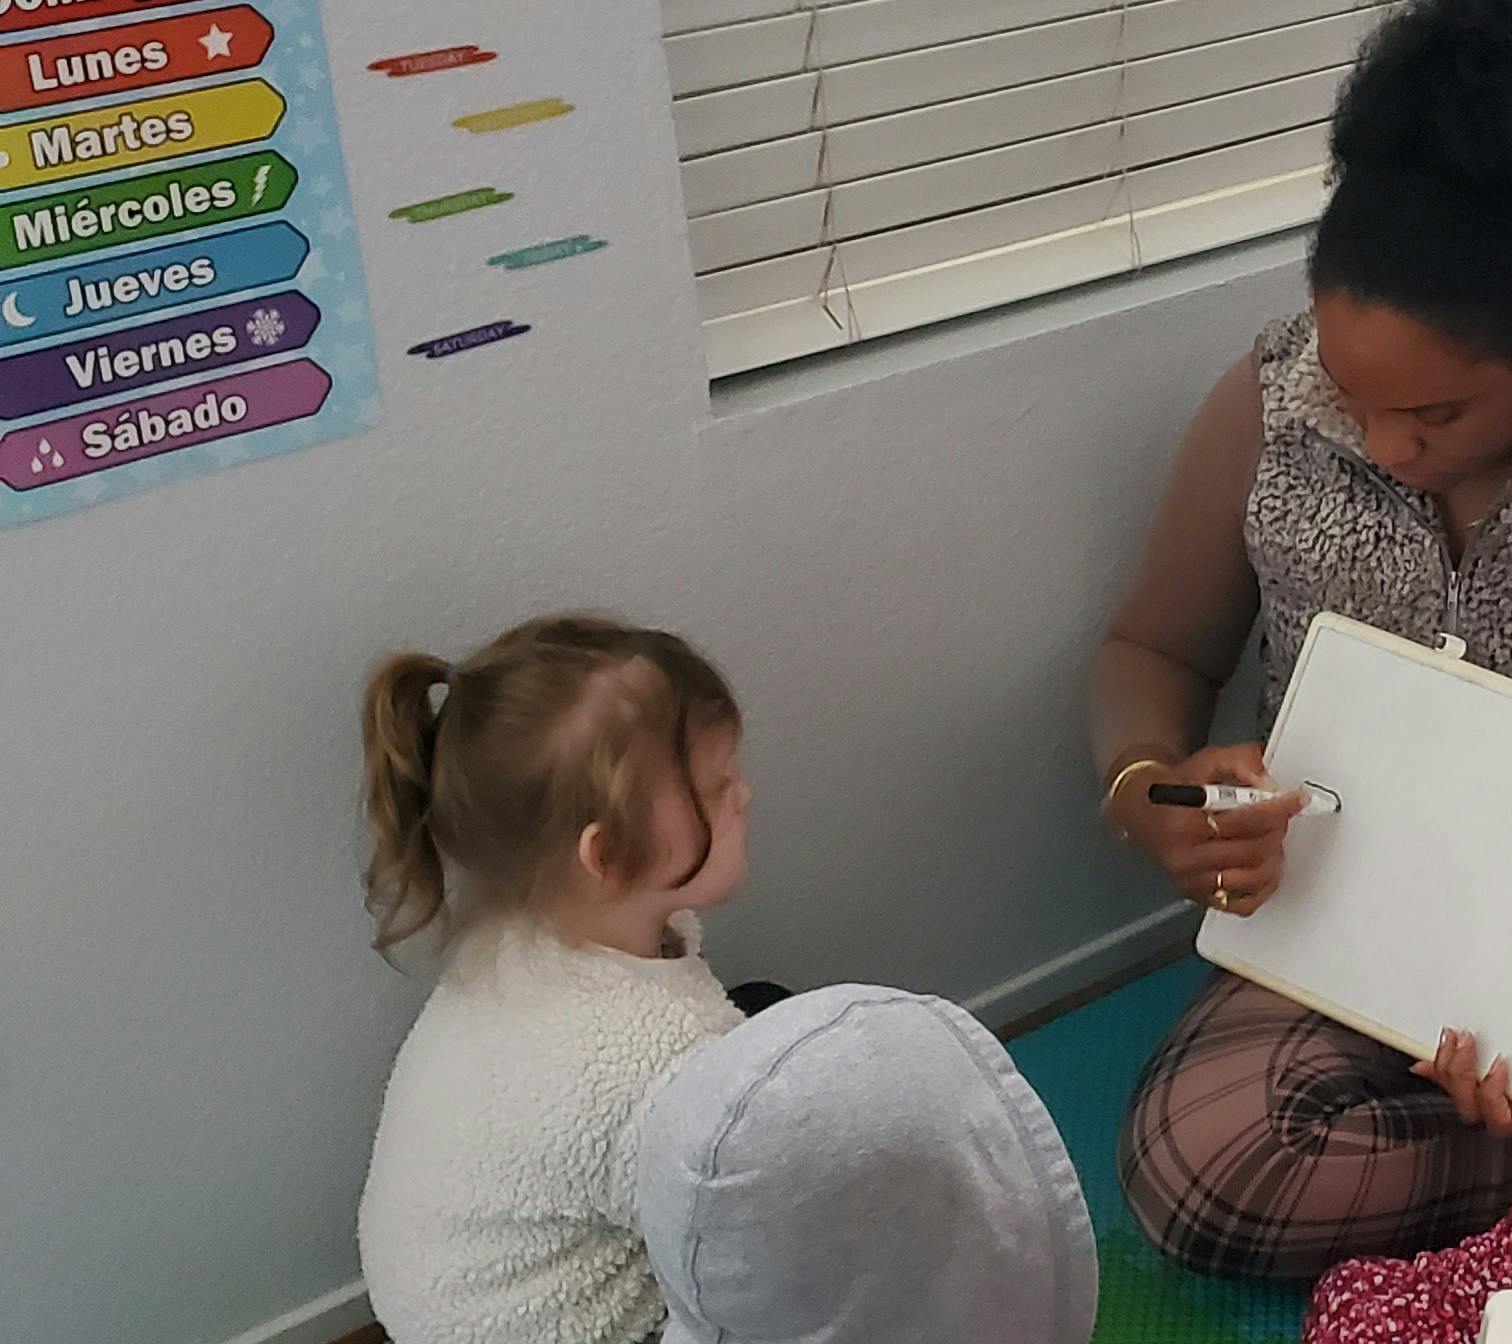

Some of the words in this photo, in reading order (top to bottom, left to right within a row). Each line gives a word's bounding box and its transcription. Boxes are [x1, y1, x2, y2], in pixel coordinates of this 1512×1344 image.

[27, 40, 168, 91] Lunes
[30, 112, 194, 168] Martes
[12, 180, 236, 250] Miércoles
[64, 258, 215, 316] Jueves
[65, 326, 238, 388] Viernes
[82, 394, 247, 458] Sábado
